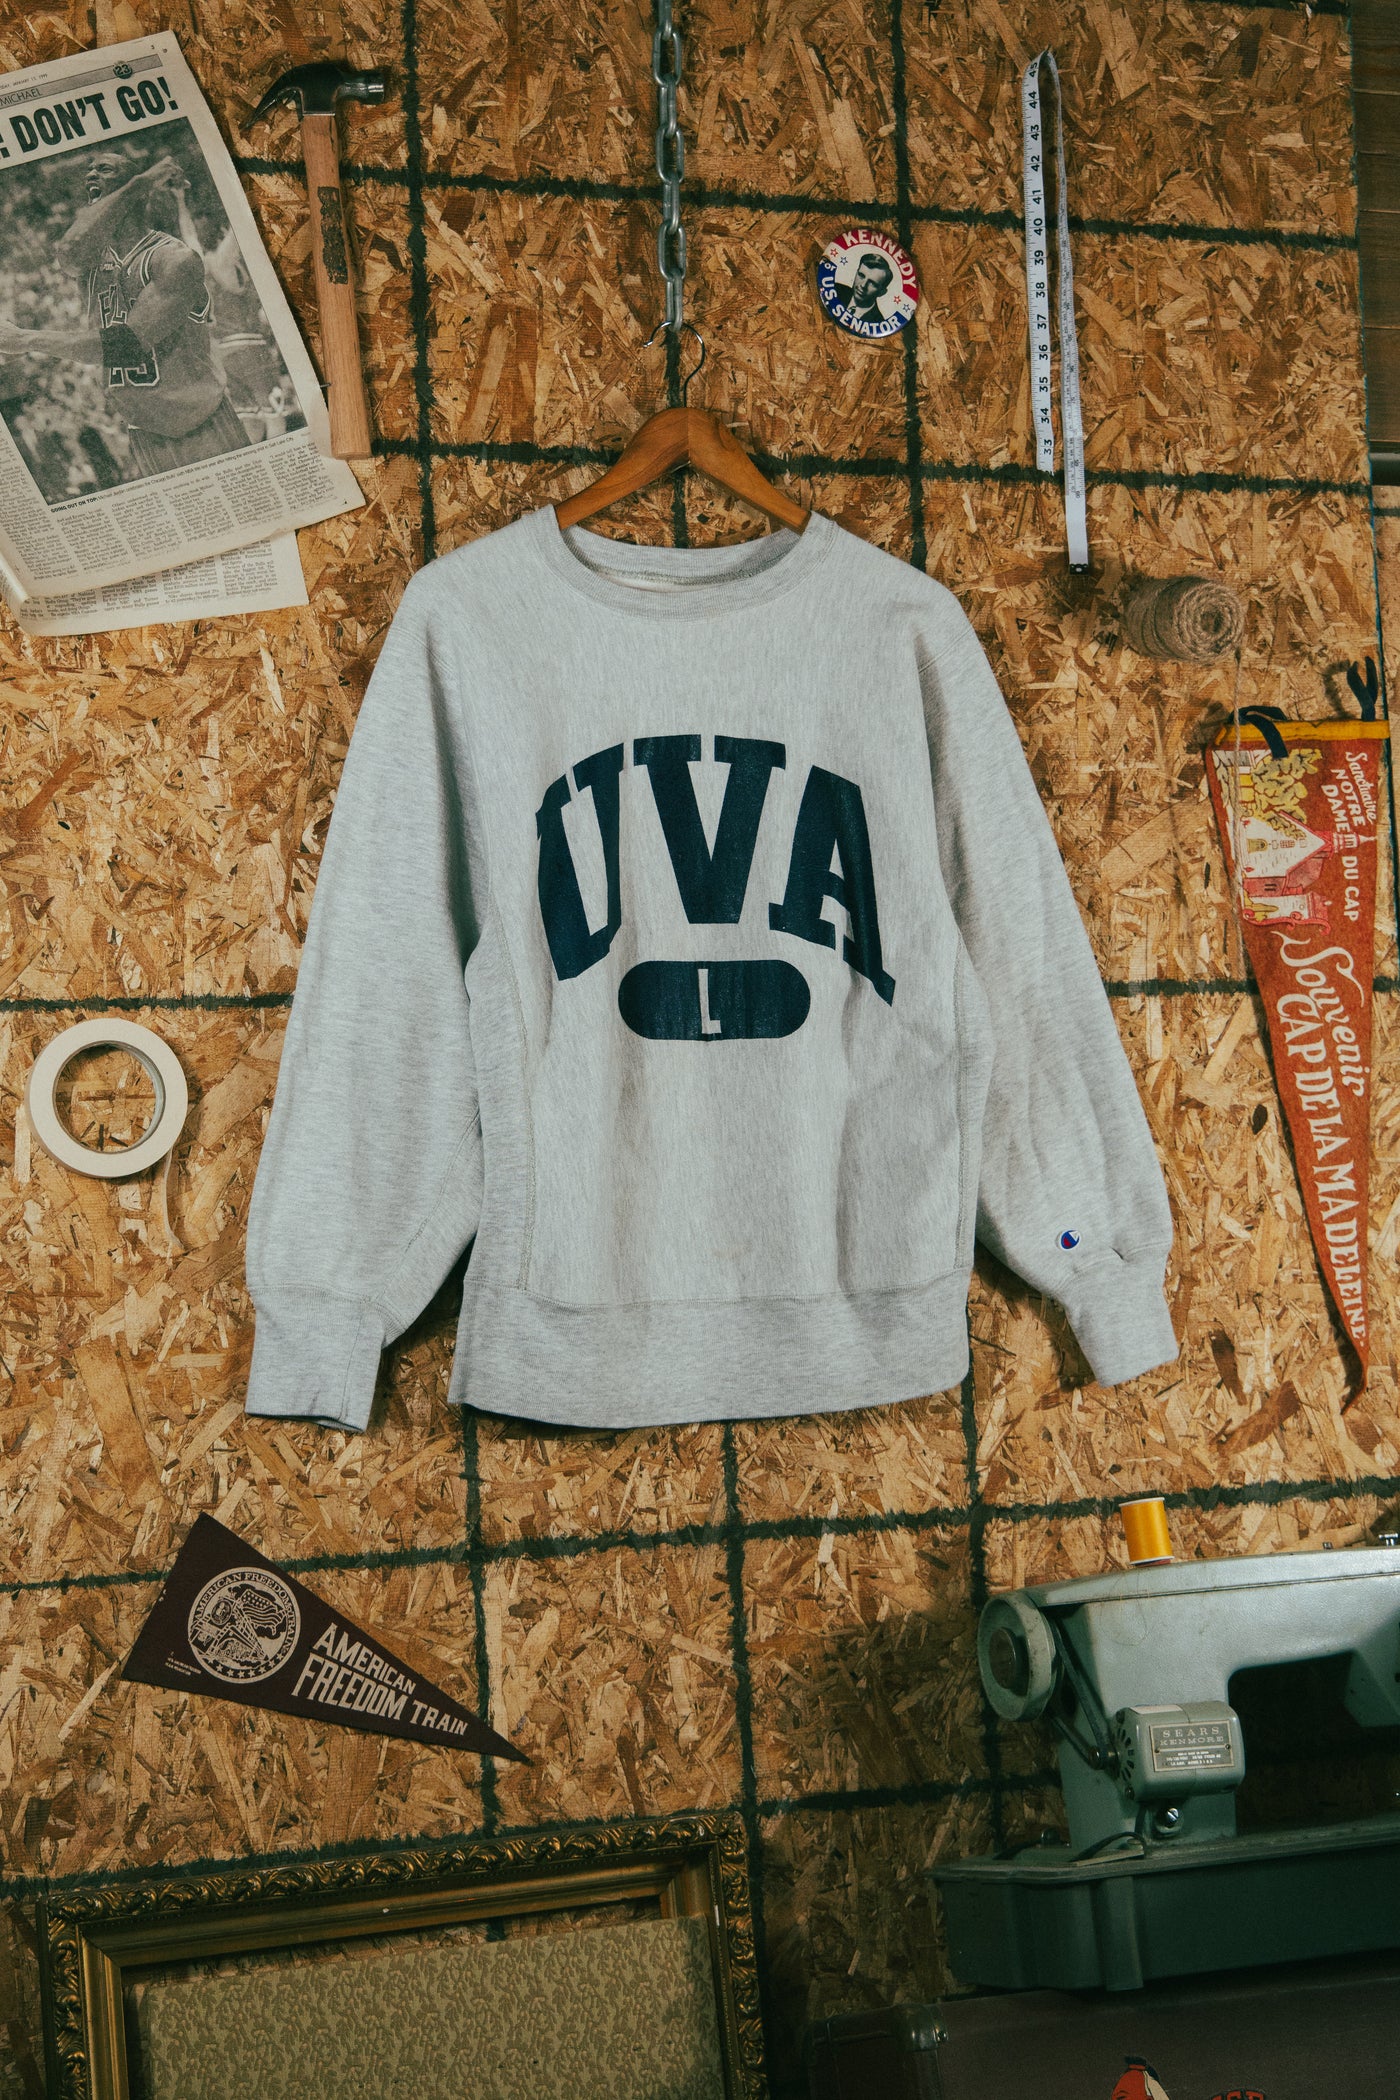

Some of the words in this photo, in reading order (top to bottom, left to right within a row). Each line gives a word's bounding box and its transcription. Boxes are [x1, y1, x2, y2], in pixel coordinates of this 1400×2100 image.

[114, 64, 130, 75] 23
[1029, 62, 1038, 77] 45
[0, 88, 42, 106] MICHAEL
[1028, 90, 1038, 109] 44
[9, 92, 111, 153] DON'T
[116, 76, 179, 122] GO!
[1030, 124, 1040, 141] 43
[1031, 154, 1040, 172] 42
[1032, 189, 1042, 205] 41
[1035, 217, 1044, 236] 40
[842, 229, 917, 289] KENNEDY
[1035, 249, 1045, 266] 39
[1036, 281, 1046, 298] 38
[832, 304, 902, 336] SENATOR
[1037, 314, 1047, 330] 37
[1039, 344, 1049, 360] 36
[1039, 376, 1049, 392] 35
[1041, 407, 1050, 424] 34
[1044, 439, 1052, 455] 33
[1331, 768, 1366, 827] NOTRE
[1345, 751, 1378, 825] Sanctuaire
[1320, 784, 1351, 834] DAME
[535, 733, 896, 1007] UVA
[1341, 855, 1360, 880] DU
[1344, 886, 1360, 922] CAP
[697, 968, 722, 1034] L
[1270, 930, 1372, 1098] Souvenir
[1276, 993, 1327, 1064] CAP
[1293, 1066, 1341, 1112] DE
[1307, 1112, 1351, 1160] LA
[194, 1574, 241, 1619] AMERICAN
[245, 1572, 293, 1611] FREEDOM
[313, 1622, 416, 1695] AMERICAN
[290, 1653, 406, 1721] FREEDOM
[411, 1699, 468, 1737] TRAIN
[1160, 1736, 1224, 1746] KENMORE
[1162, 1726, 1221, 1738] SEARS
